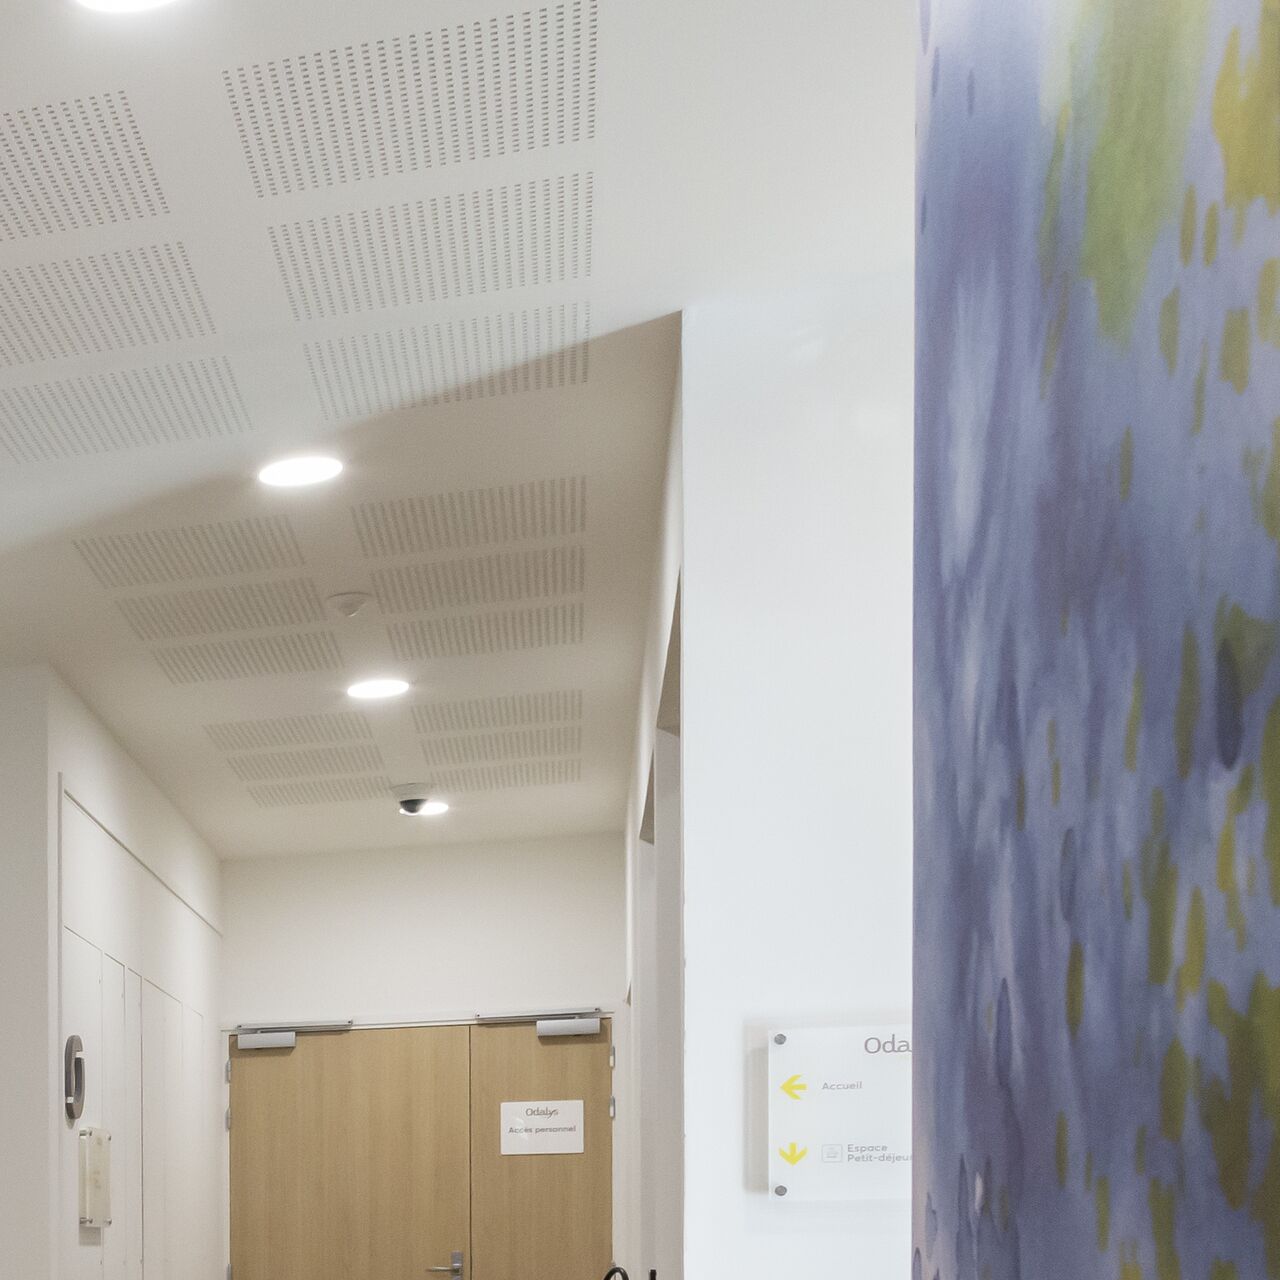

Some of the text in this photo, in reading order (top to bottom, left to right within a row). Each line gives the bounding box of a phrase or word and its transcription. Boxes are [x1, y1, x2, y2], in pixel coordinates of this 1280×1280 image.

[821, 1081, 863, 1091] Accueil
[525, 1106, 559, 1120] Odalys
[535, 1125, 577, 1134] personnel
[847, 1143, 889, 1154] Espace
